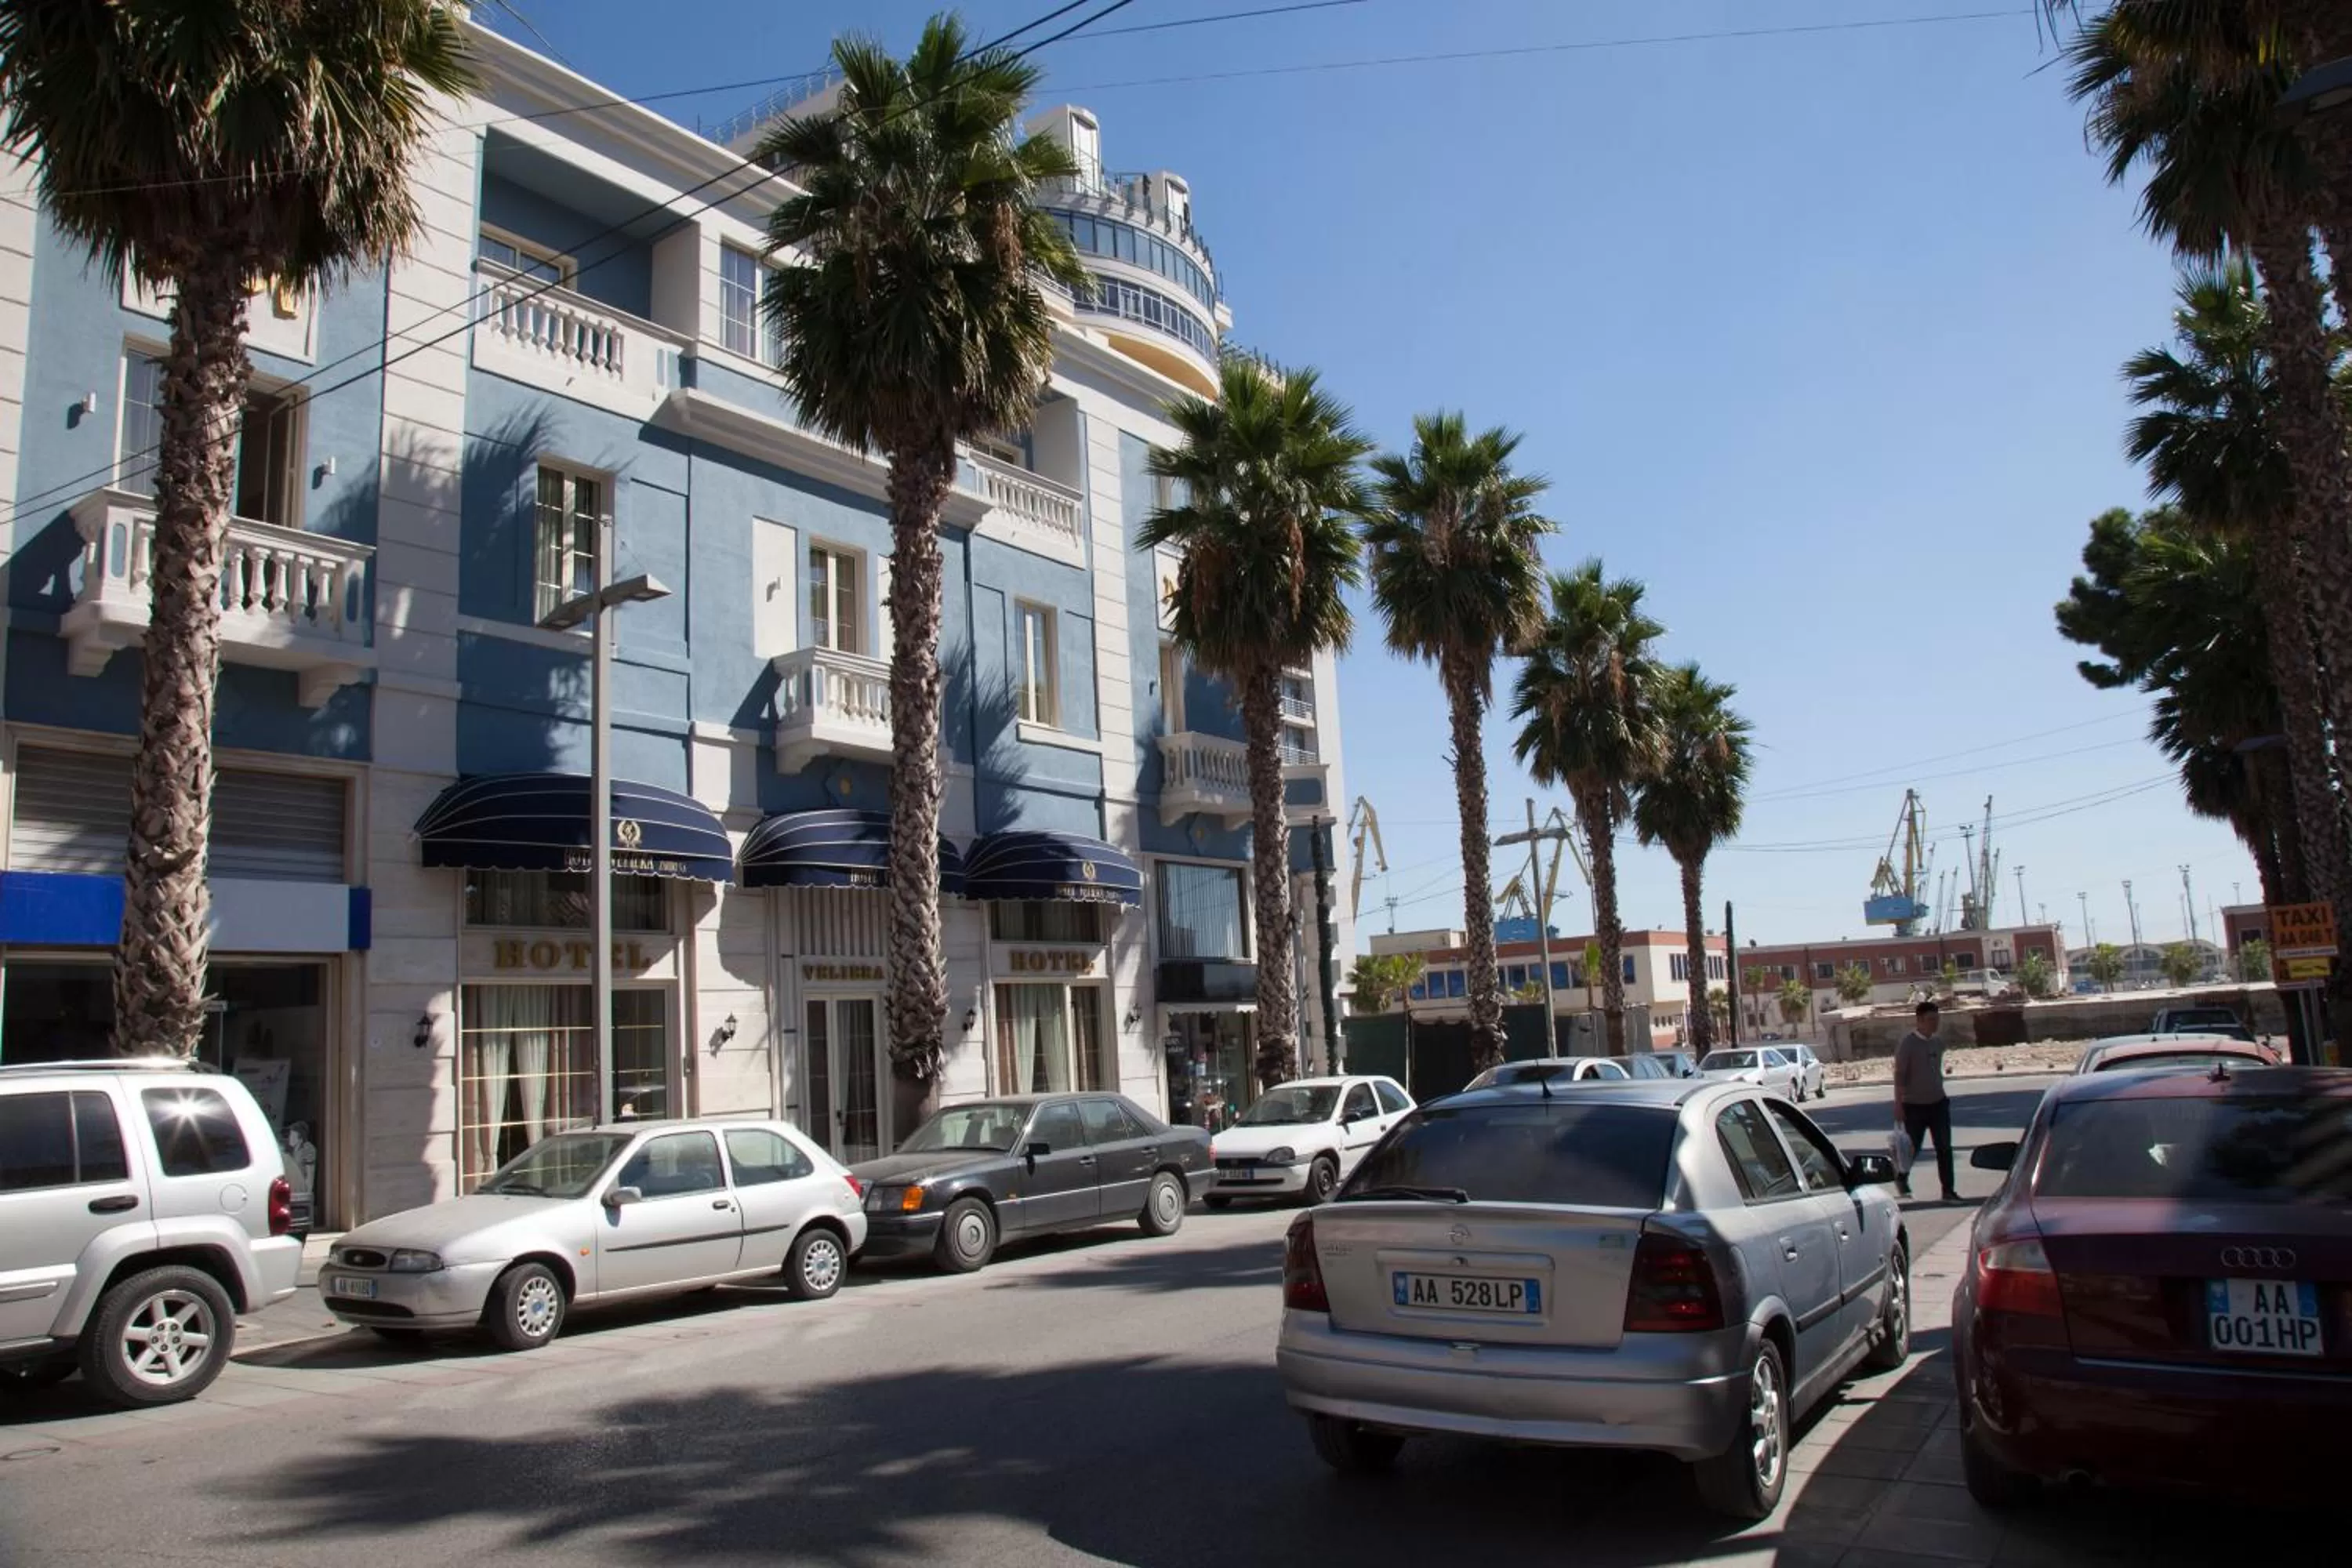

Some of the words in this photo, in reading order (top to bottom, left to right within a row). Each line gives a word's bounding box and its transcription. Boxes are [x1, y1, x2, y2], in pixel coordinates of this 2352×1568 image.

[2275, 906, 2328, 927] TAXI
[1010, 949, 1094, 973] HOTEL
[1414, 1278, 1439, 1304] AA
[1451, 1280, 1523, 1308] 528LP
[2254, 1283, 2290, 1314] AA
[2215, 1316, 2318, 1349] 001HP
